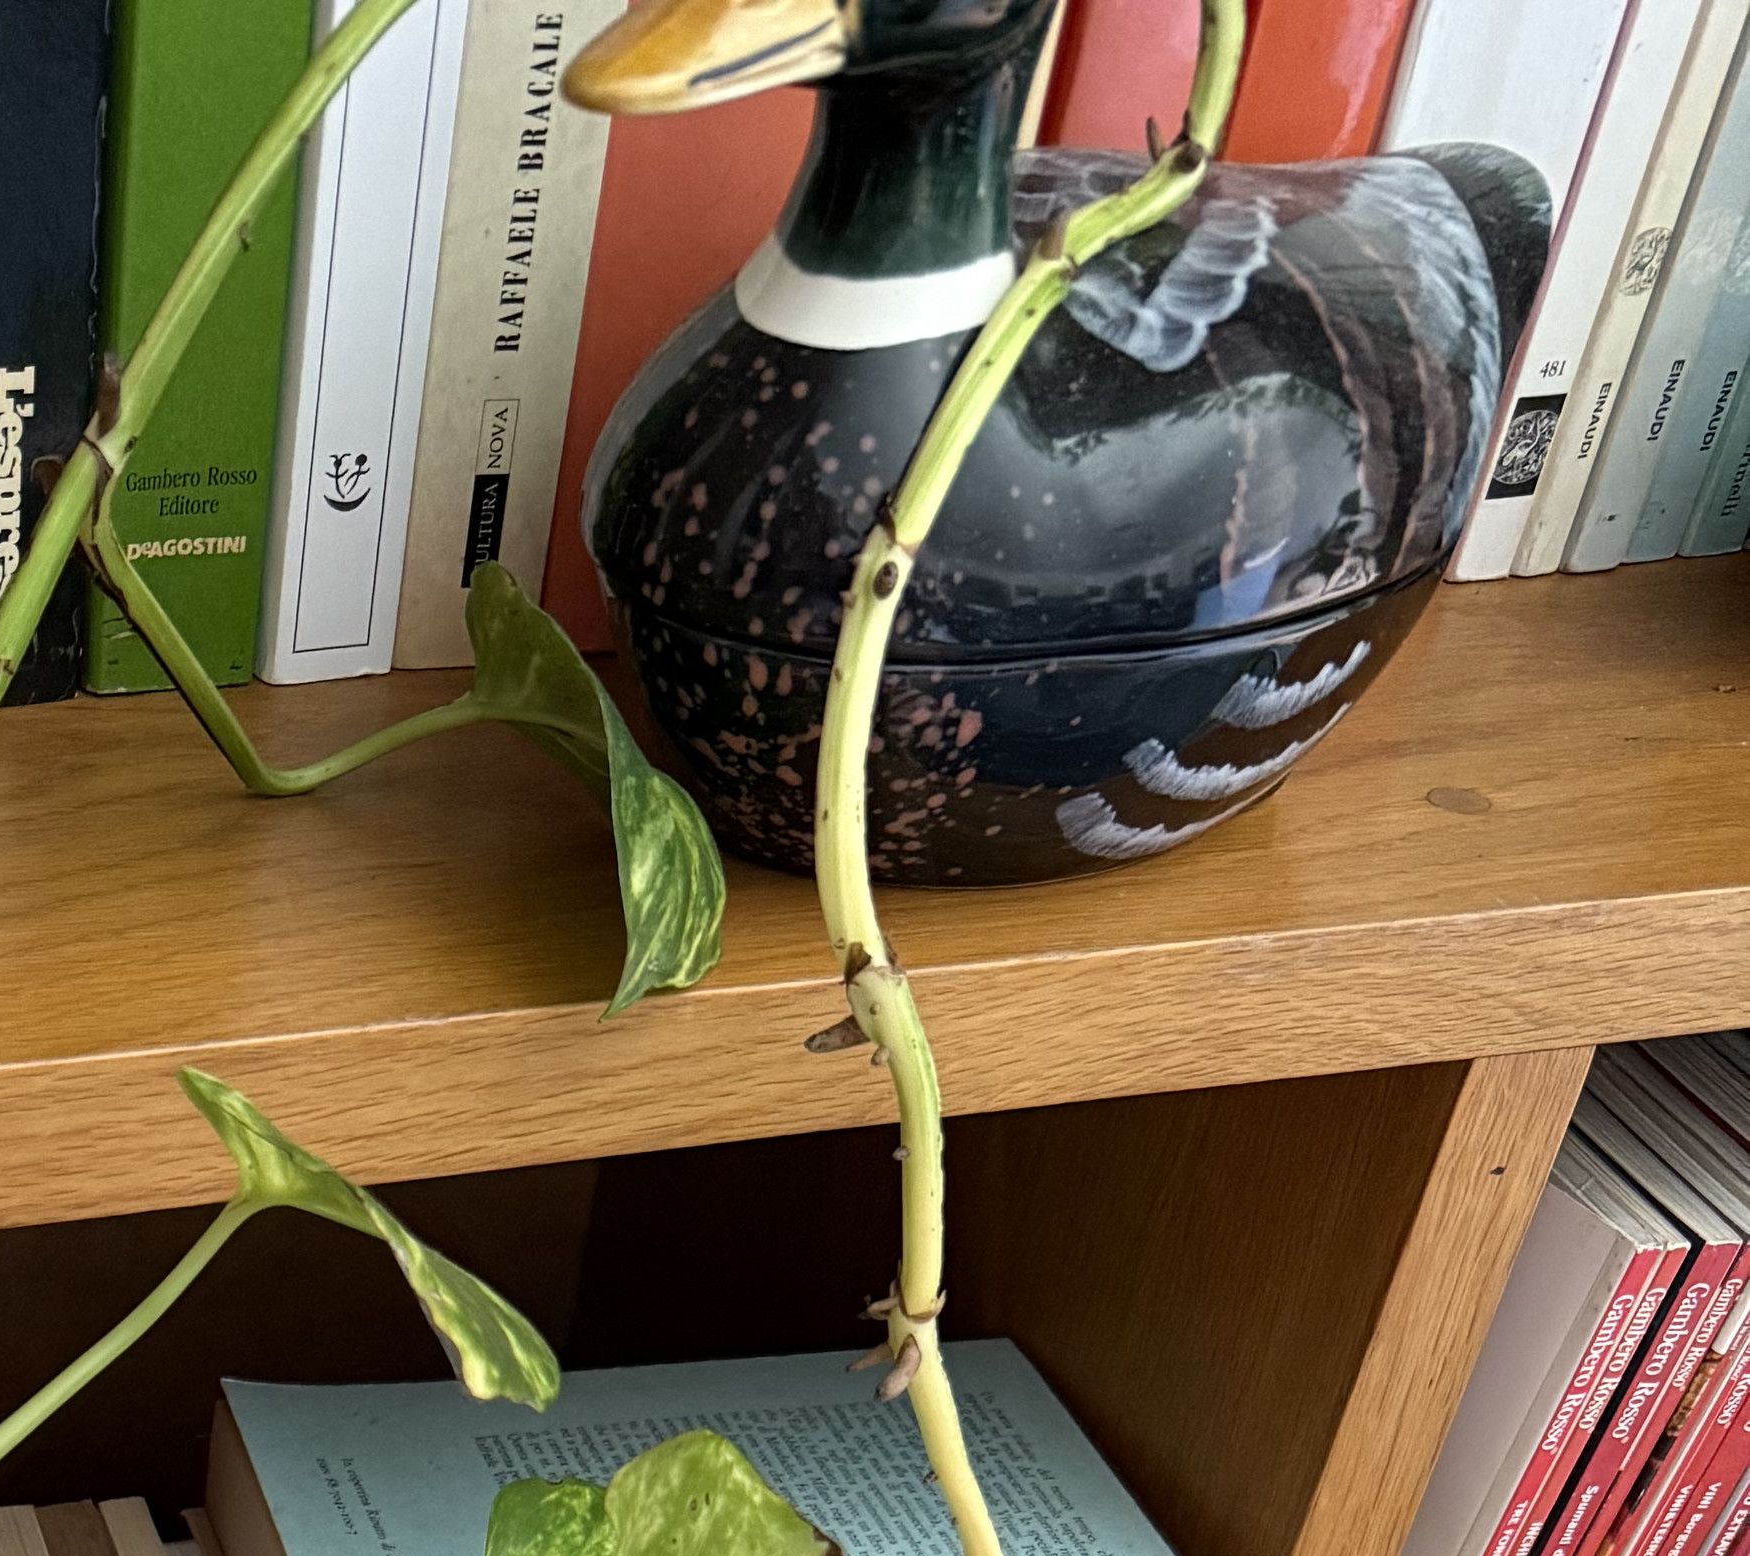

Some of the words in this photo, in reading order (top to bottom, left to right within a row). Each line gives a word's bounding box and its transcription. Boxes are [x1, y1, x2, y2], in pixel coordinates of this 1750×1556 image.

[494, 188, 541, 355] RAFFAELE
[518, 12, 562, 172] BRACALE
[1540, 360, 1566, 378] 481
[1647, 359, 1685, 440] EINAUDI
[486, 406, 509, 470] NOVA
[1578, 382, 1612, 459] EINAUDI
[1700, 371, 1737, 451] EINAUDI
[126, 468, 201, 492] Gambero
[208, 467, 257, 486] Rosso
[159, 496, 219, 517] Editore
[1570, 1288, 1637, 1389] Gambero
[1605, 1281, 1668, 1377] Gambero
[1641, 1276, 1712, 1382] Gambero
[1693, 1272, 1745, 1347] Gambero
[1670, 1342, 1706, 1391] Rosso
[1538, 1390, 1585, 1455] Rosso
[1575, 1378, 1616, 1434] Rosso
[1608, 1377, 1657, 1445] Rosso
[1555, 1481, 1600, 1548] Spumanti
